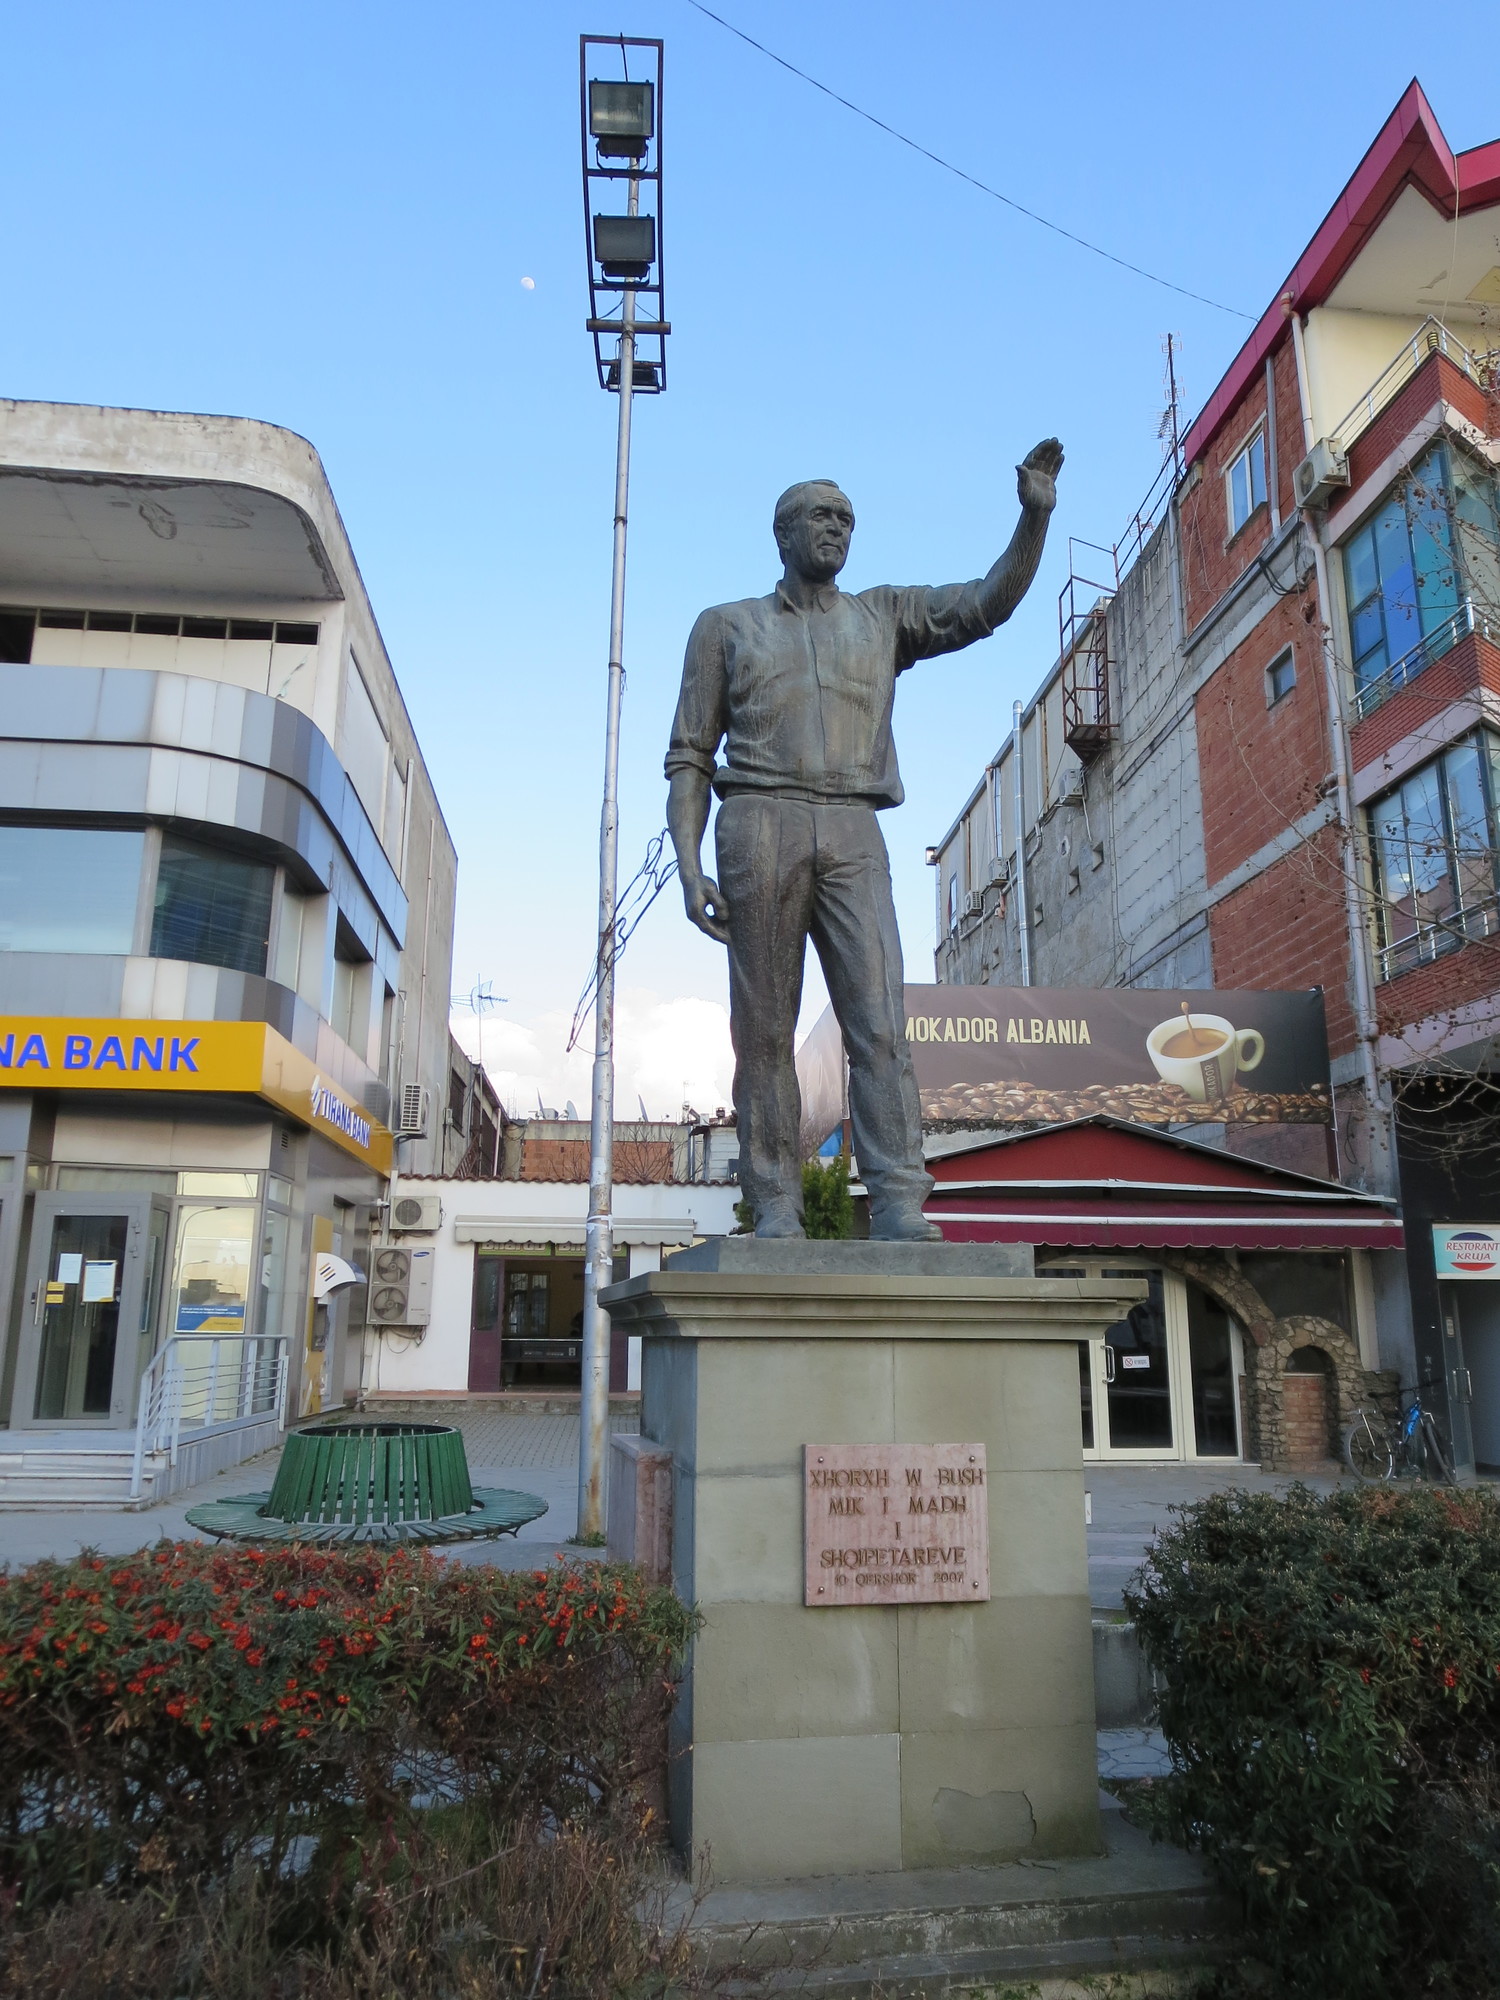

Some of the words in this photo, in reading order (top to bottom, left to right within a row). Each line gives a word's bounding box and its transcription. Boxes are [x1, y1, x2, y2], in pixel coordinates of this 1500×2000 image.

[1006, 1018, 1091, 1044] ALBANIA
[63, 1035, 200, 1072] BANK
[321, 1087, 351, 1135] TIRANA
[350, 1111, 371, 1150] BANK
[1446, 1242, 1500, 1251] RESTORANT
[1456, 1252, 1491, 1261] KRUJA
[810, 1468, 890, 1488] XHORXH
[905, 1468, 923, 1487] W
[938, 1467, 984, 1487] BUSH
[829, 1496, 865, 1516] MIK
[882, 1496, 889, 1515] I
[908, 1495, 967, 1515] MADH
[895, 1521, 902, 1541] I
[820, 1547, 967, 1569] SHQIPETAREVE
[834, 1573, 848, 1586] 10
[855, 1571, 918, 1587] QERSHOR
[933, 1570, 965, 1584] 2007
